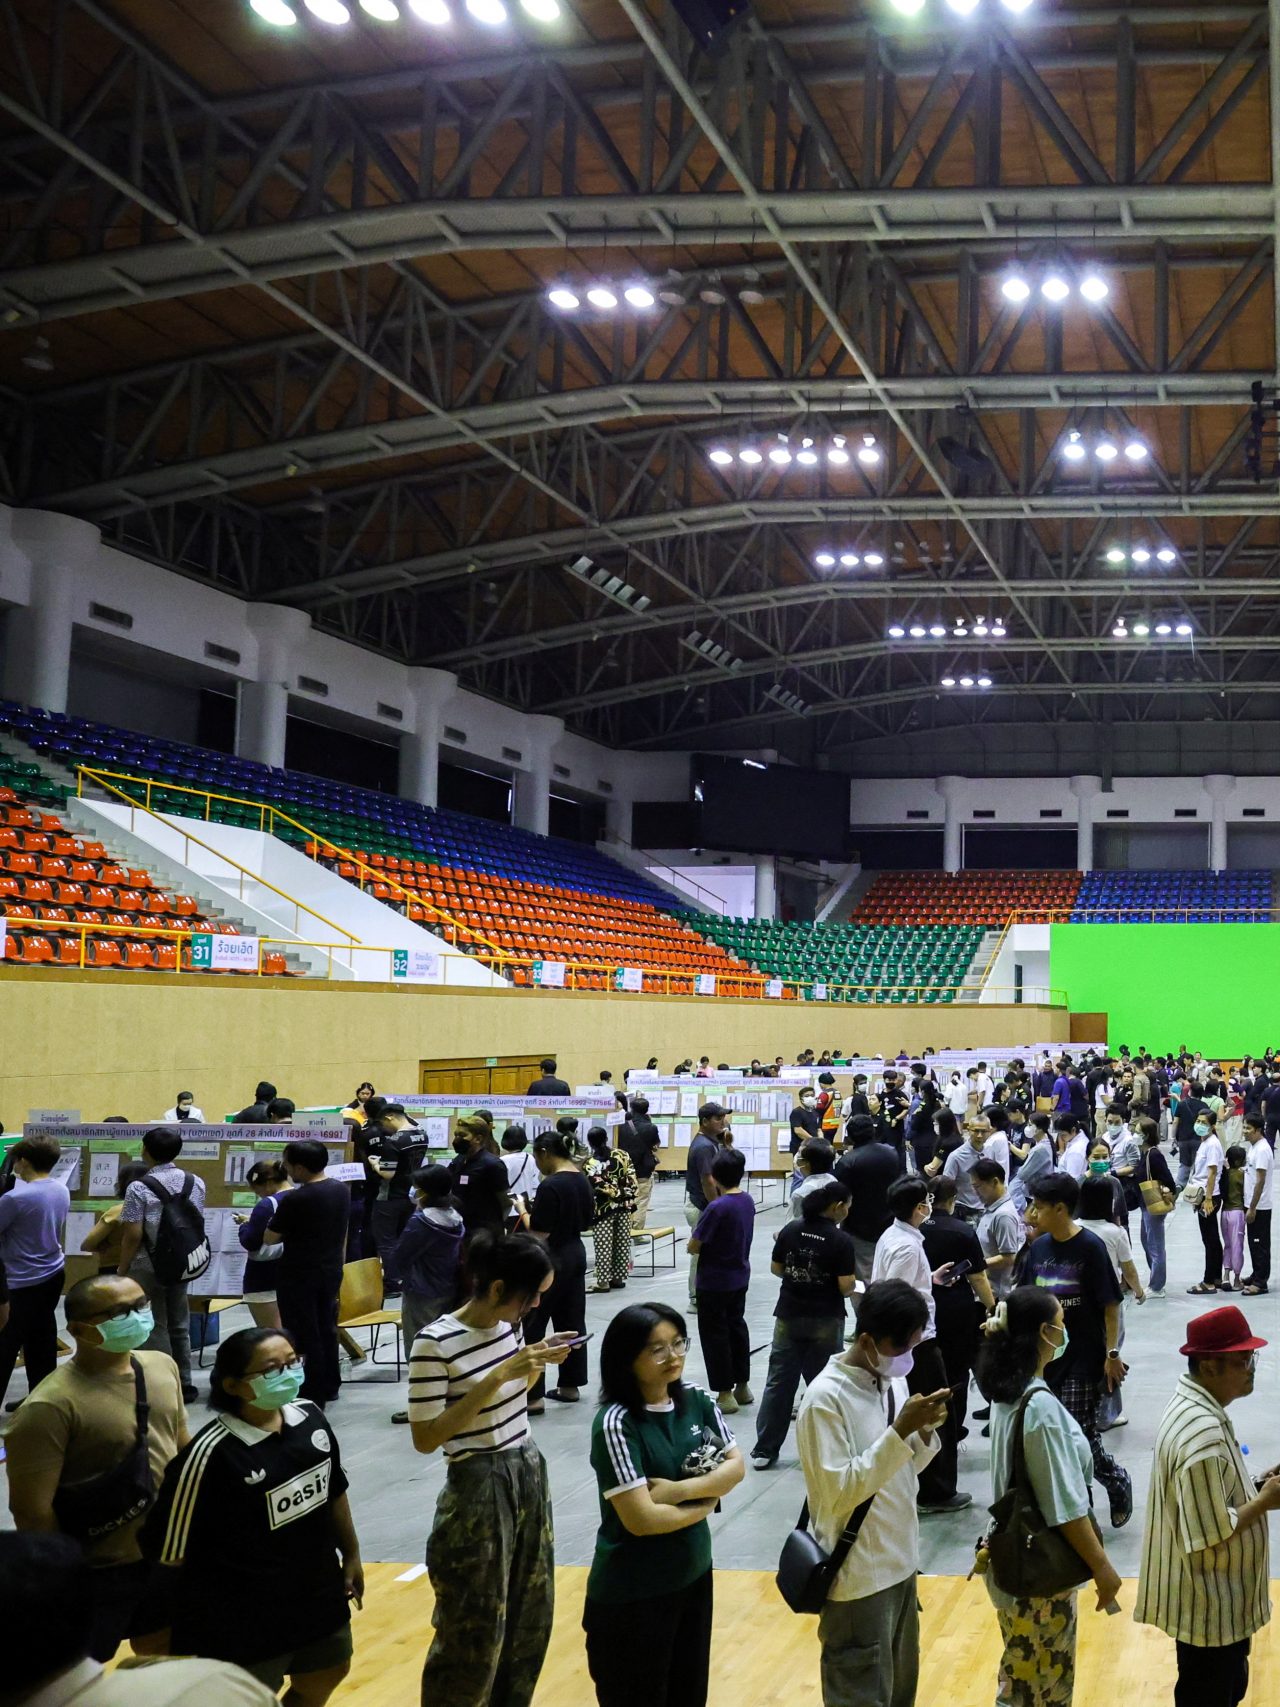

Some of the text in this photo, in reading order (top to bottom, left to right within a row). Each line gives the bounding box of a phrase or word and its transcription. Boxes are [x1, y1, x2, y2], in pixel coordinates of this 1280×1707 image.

[193, 945, 210, 960] 31
[218, 940, 253, 954] ร้อยเอ็ด
[394, 959, 407, 970] 32
[29, 1126, 149, 1139] การเลือกตั้งสมาชิกสภาผู้แทนราษ
[189, 1129, 224, 1139] (นอกเขต)
[245, 1129, 256, 1138] 28
[258, 1128, 284, 1139] ลำดับที่
[286, 1130, 311, 1138] 16389
[321, 1130, 344, 1139] 16991
[92, 1177, 113, 1186] 4/23
[187, 1238, 210, 1272] NIK
[88, 1498, 148, 1536] DICKIES
